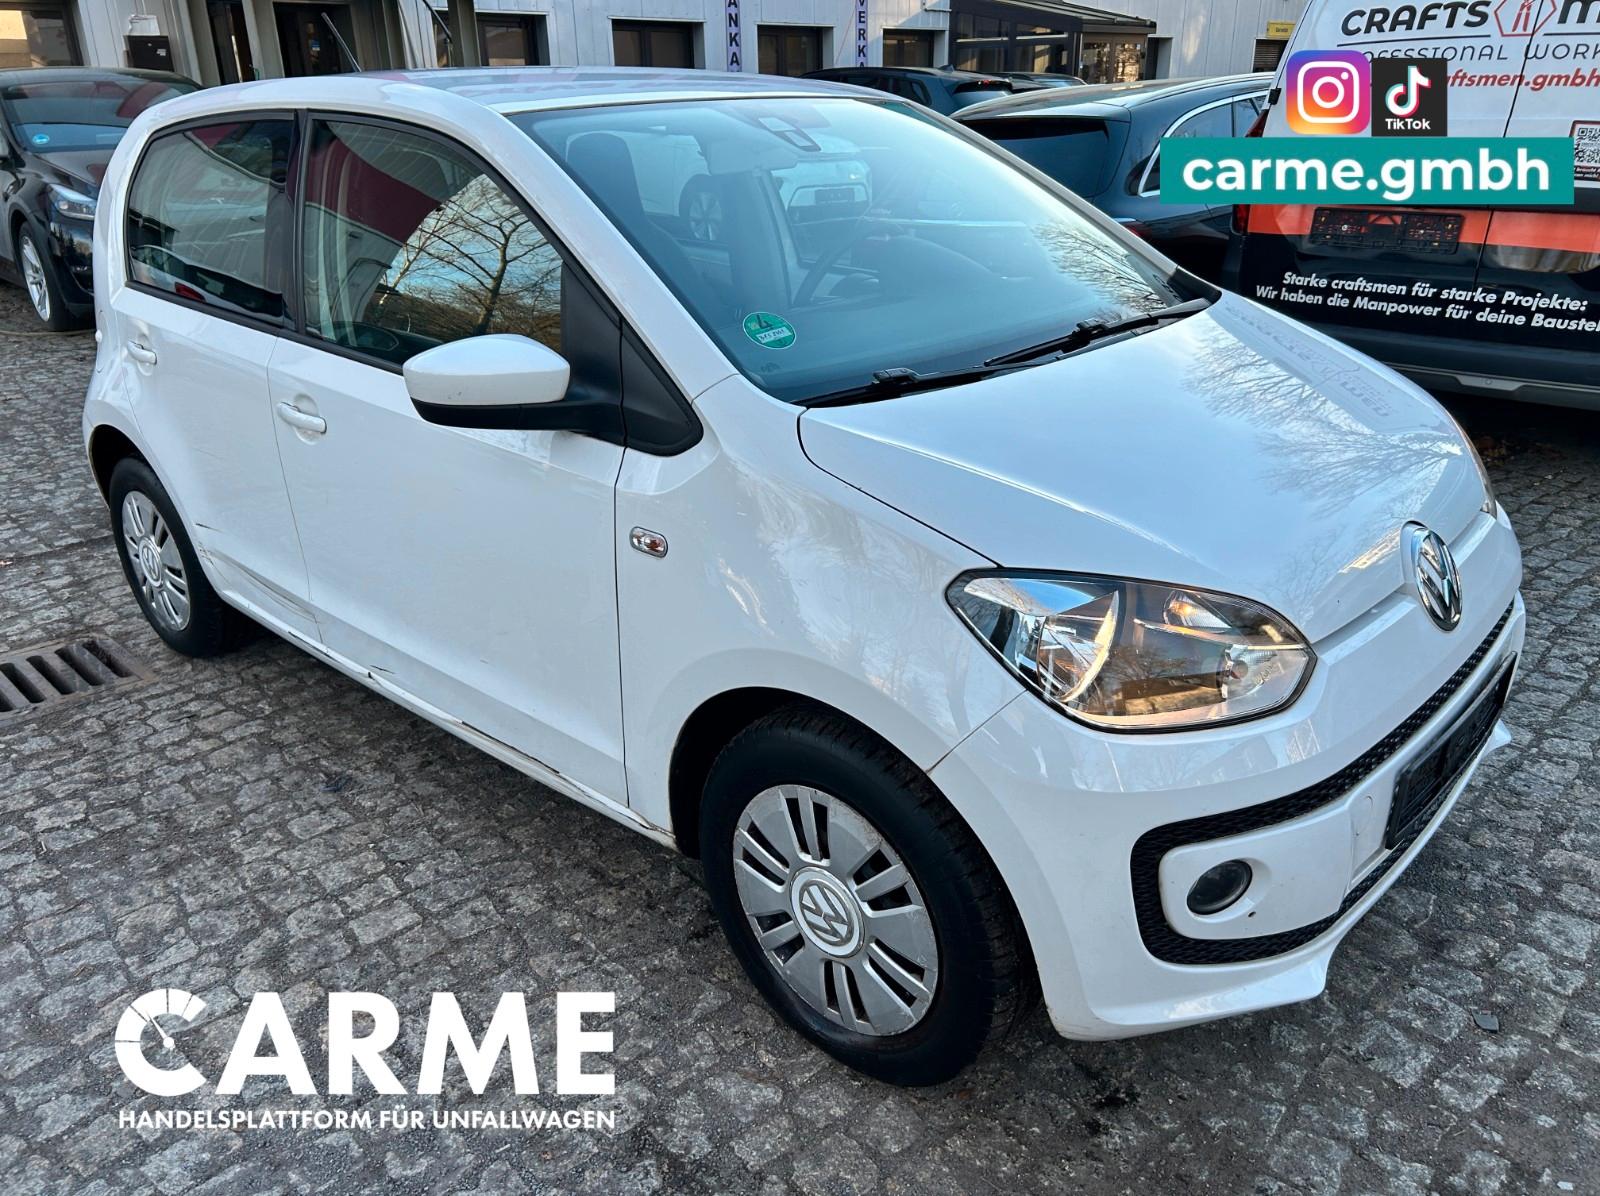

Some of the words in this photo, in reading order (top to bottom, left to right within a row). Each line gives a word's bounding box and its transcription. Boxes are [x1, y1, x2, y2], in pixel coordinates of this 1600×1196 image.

[728, 0, 740, 72] ANKA
[1341, 0, 1492, 36] CRAFTS
[1256, 285, 1278, 299] Wir
[1280, 287, 1322, 304] haben
[1327, 293, 1349, 307] die
[1353, 296, 1442, 317] Manpower
[1445, 304, 1472, 319] für
[1475, 308, 1526, 325] deine
[1282, 272, 1328, 288] Starke
[1331, 277, 1407, 295] craftsmen
[1411, 282, 1437, 298] für
[1440, 287, 1497, 303] starke
[1501, 291, 1588, 311] Projekte:
